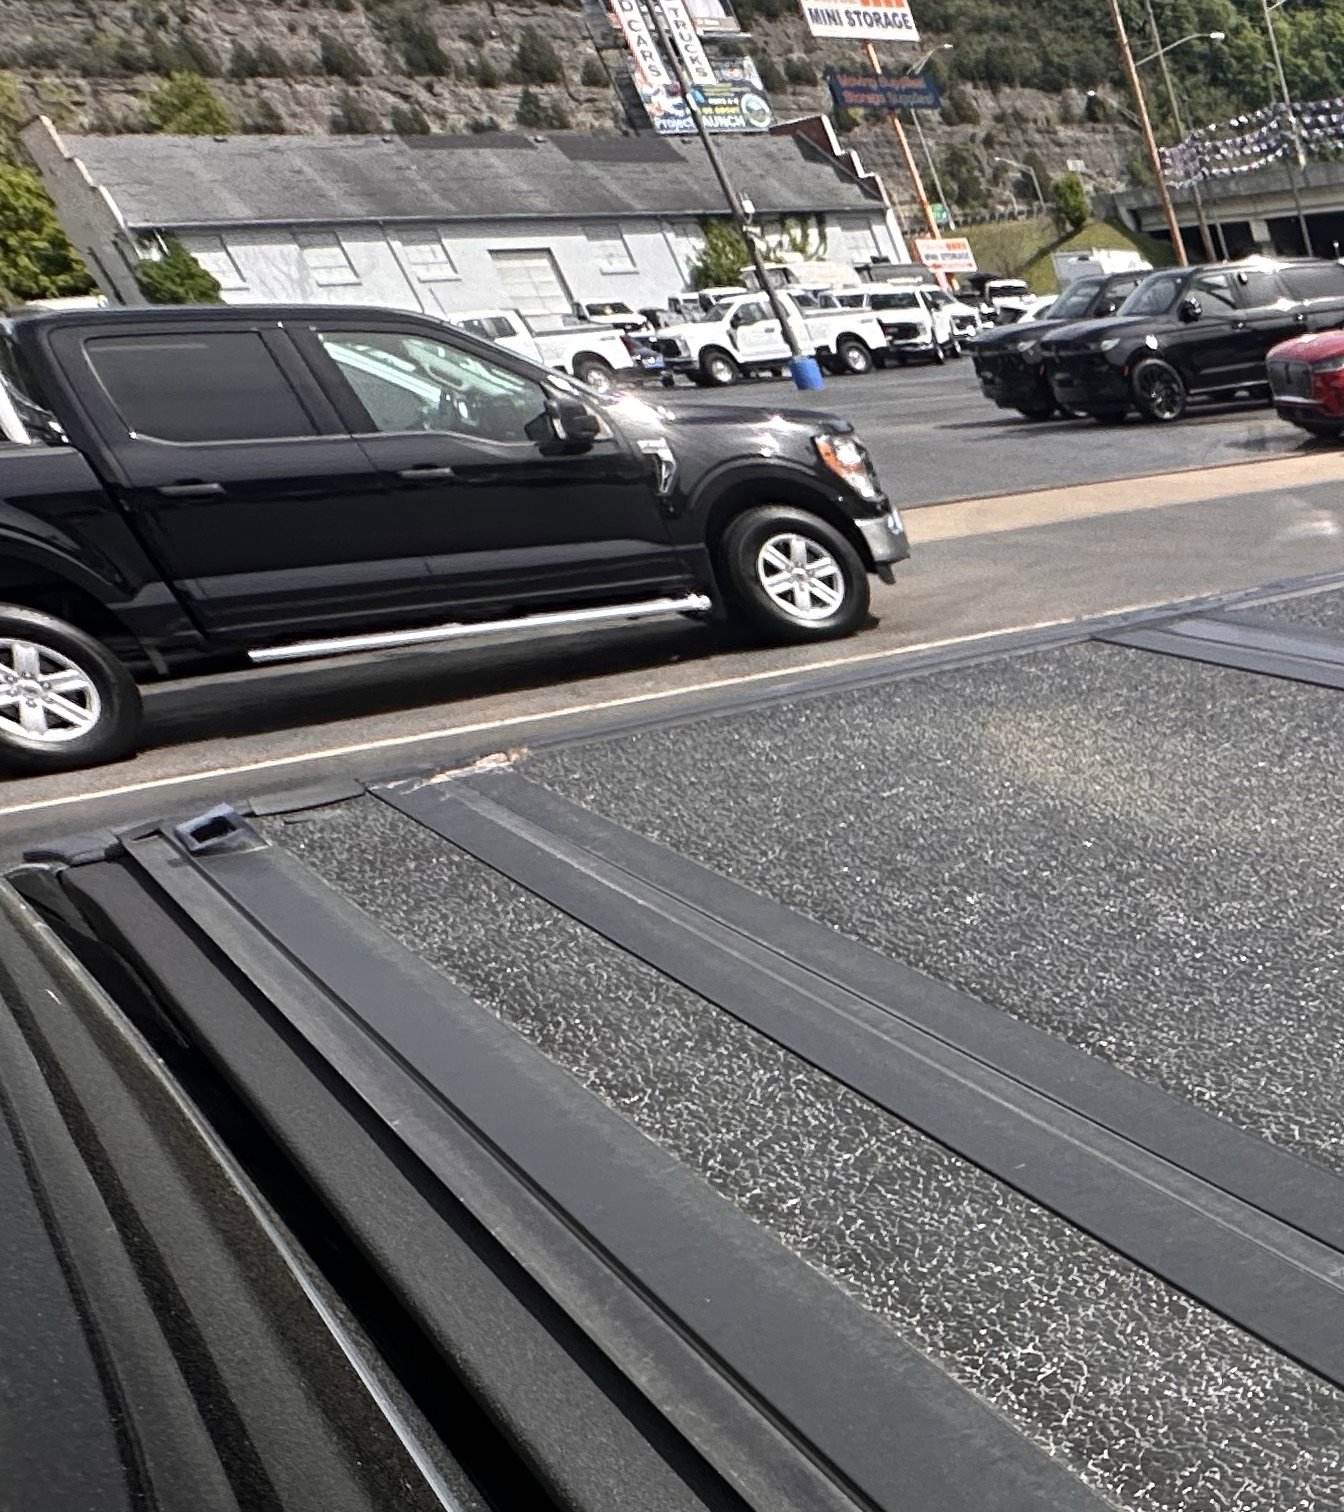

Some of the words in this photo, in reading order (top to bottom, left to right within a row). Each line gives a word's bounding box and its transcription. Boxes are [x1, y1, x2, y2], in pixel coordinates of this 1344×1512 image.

[808, 8, 844, 26] MINI
[844, 9, 913, 30] STORAGE
[627, 20, 661, 77] CARS
[668, 8, 708, 77] TRUCKS
[702, 115, 746, 128] AUNCH
